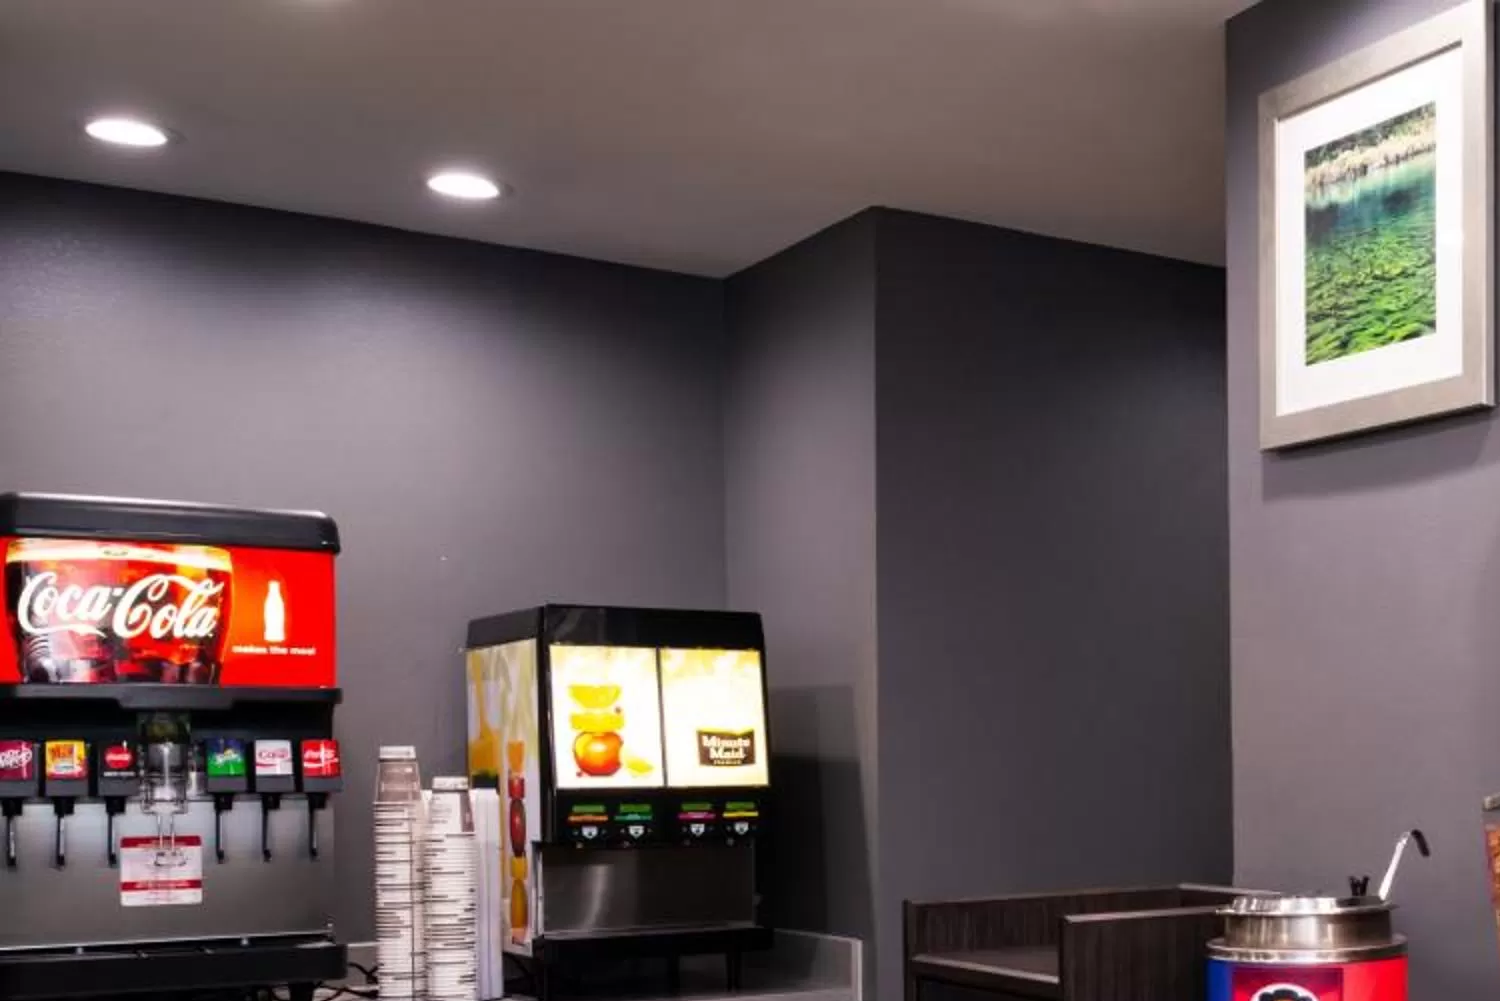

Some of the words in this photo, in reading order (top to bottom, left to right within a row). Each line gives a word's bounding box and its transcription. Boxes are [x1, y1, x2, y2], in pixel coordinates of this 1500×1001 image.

[18, 571, 224, 639] Coca-Cola
[702, 735, 751, 748] Minute
[709, 745, 747, 759] Maid
